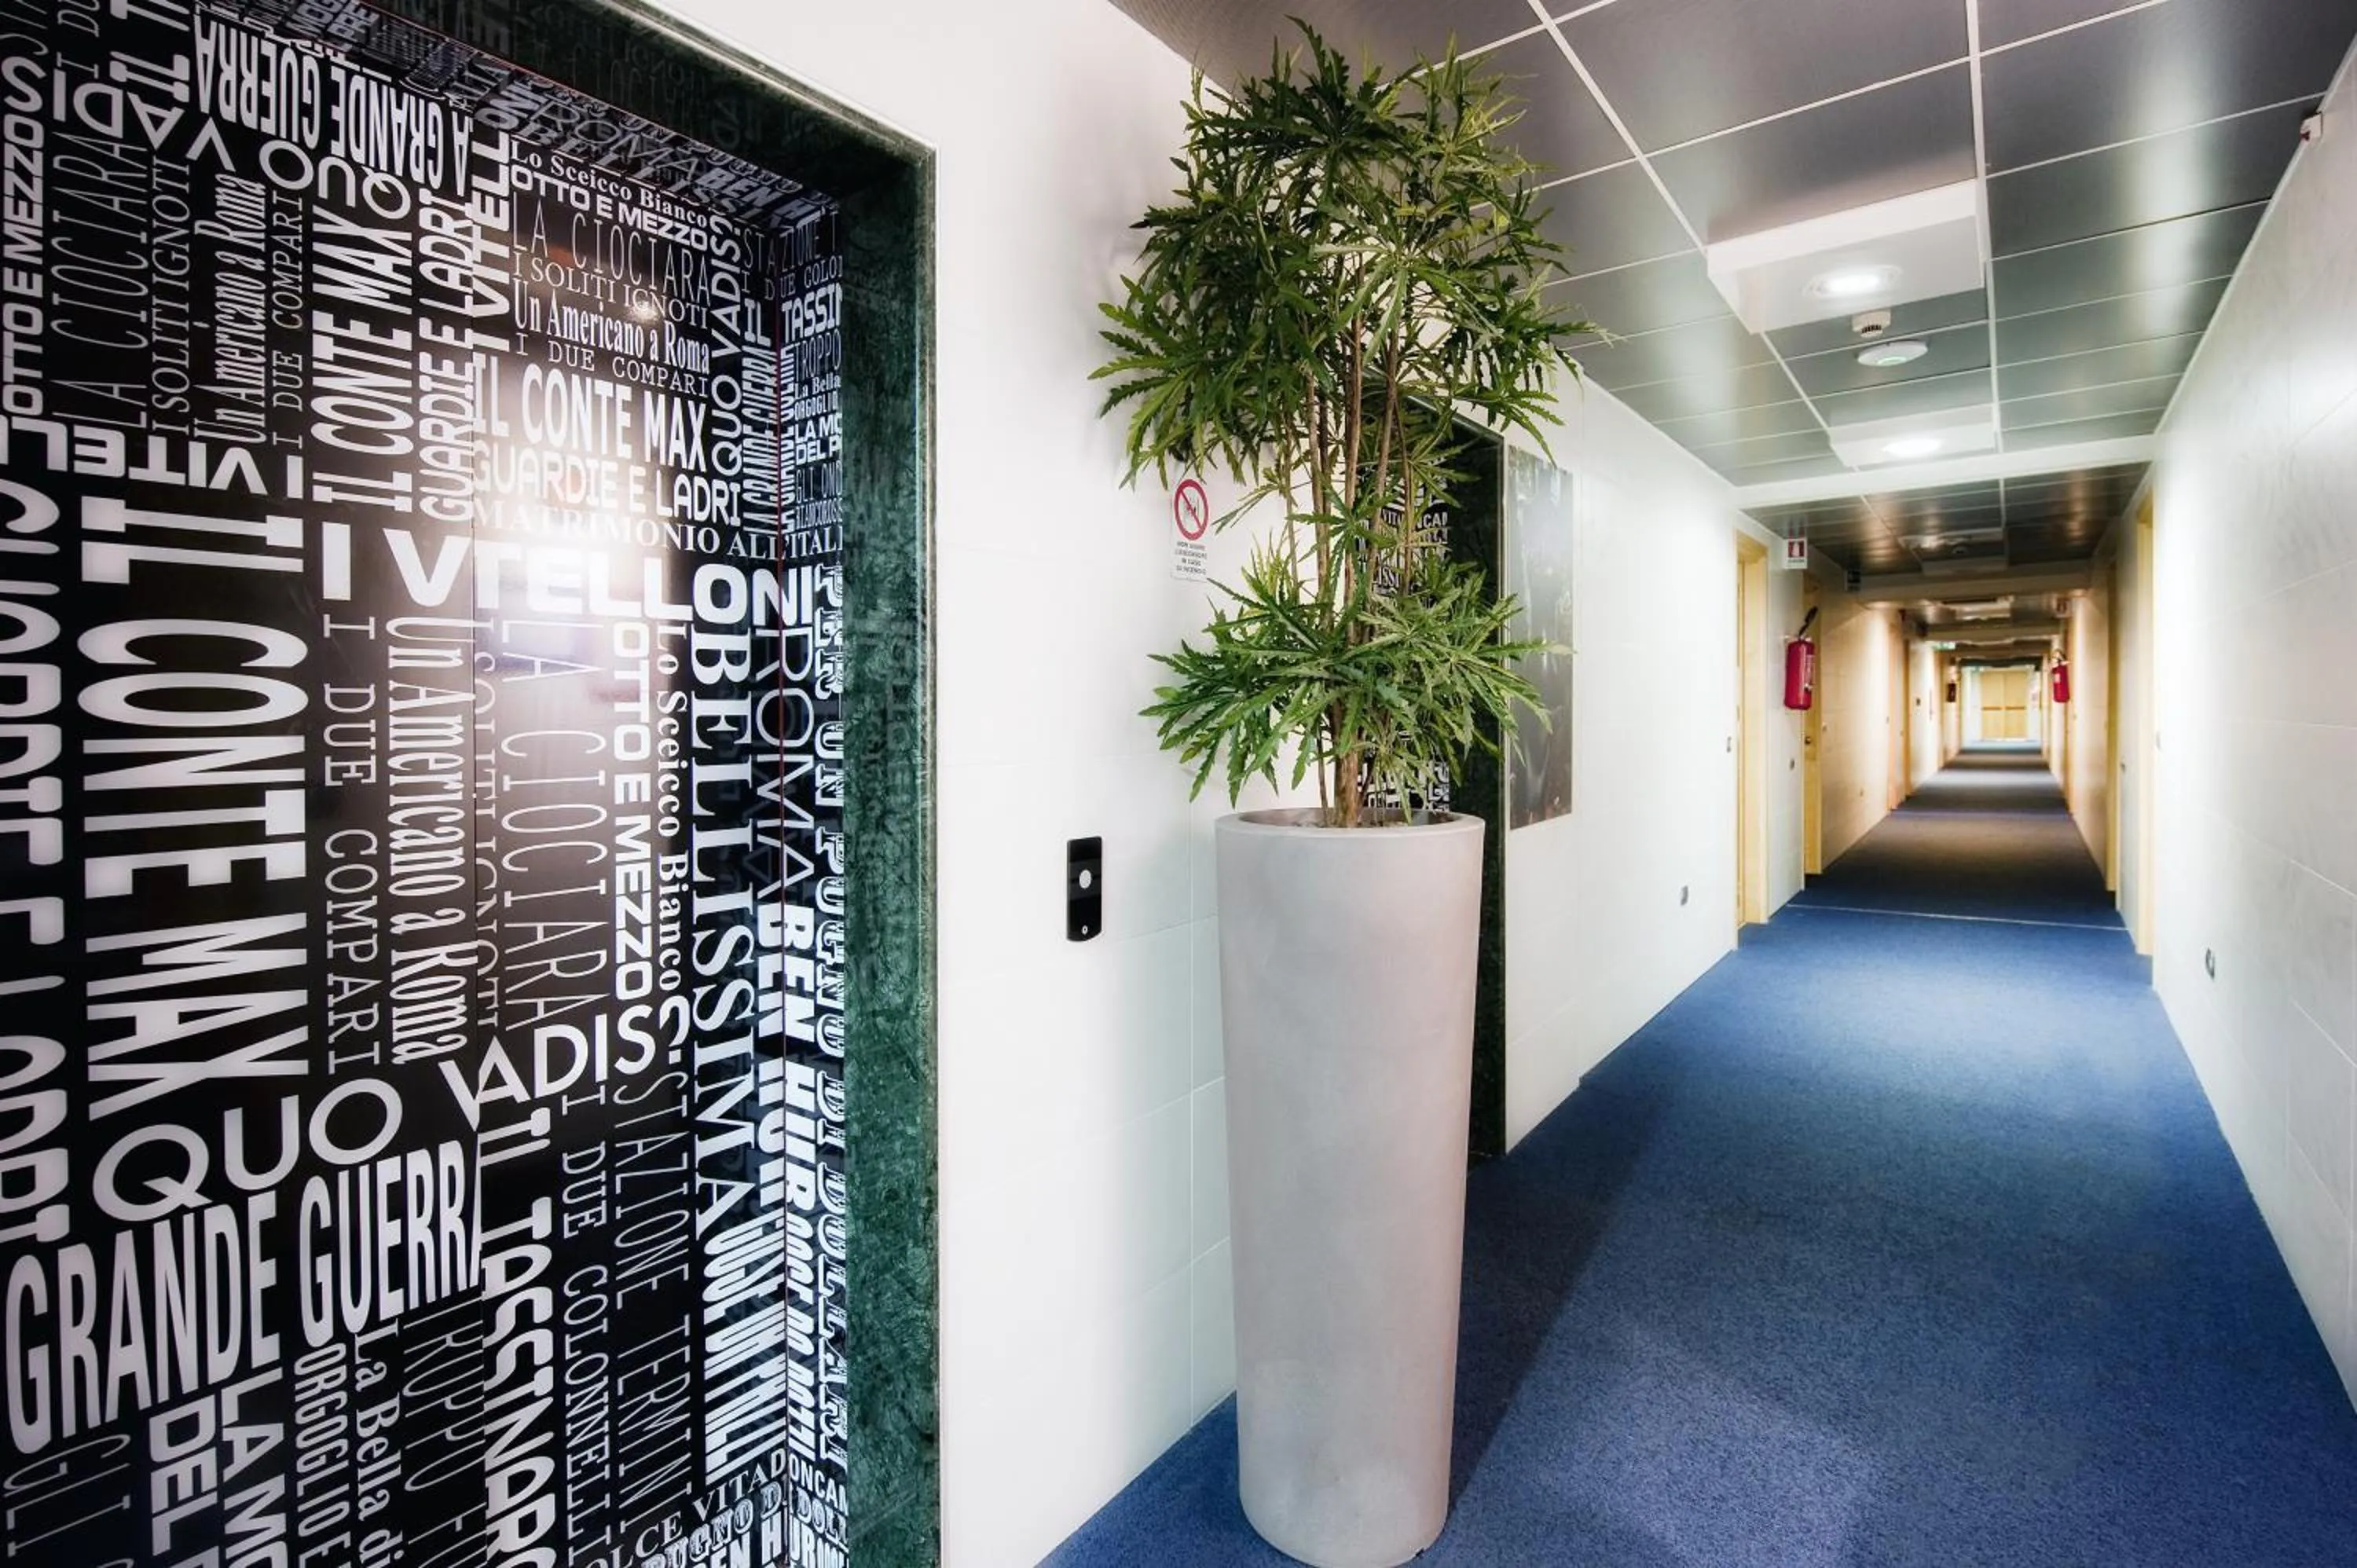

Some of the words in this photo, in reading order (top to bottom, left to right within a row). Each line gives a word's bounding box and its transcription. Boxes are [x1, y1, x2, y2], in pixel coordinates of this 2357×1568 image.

[194, 14, 321, 150] GUERRA
[330, 66, 443, 190] GRANDE
[2, 114, 44, 265] MEZZO
[152, 155, 189, 291] IGNOTI
[194, 173, 266, 252] Roma
[259, 139, 411, 220] QUO
[511, 141, 542, 171] Lo
[551, 154, 632, 200] Sceicco
[639, 185, 707, 229] Bianco
[511, 163, 590, 216] OTTO
[597, 200, 614, 218] E
[618, 203, 709, 251] MEZZO
[2, 268, 43, 299] E
[51, 131, 148, 350] CIOCIARA
[214, 251, 266, 271] a
[272, 190, 303, 330] COMPARI
[312, 203, 413, 313] MAX
[419, 191, 473, 317] LADRI
[513, 192, 548, 258] LA
[572, 212, 710, 308] CIOCIARA
[513, 251, 523, 278] I
[531, 256, 617, 303] SOLITI
[624, 281, 709, 330] IGNOTI
[709, 214, 742, 368] VADIS?
[2, 302, 43, 416] OTTO
[152, 295, 189, 412] SOLITI
[193, 274, 266, 408] Americano
[273, 350, 303, 412] DUE
[310, 309, 414, 456] CONTE
[419, 316, 473, 350] E
[471, 326, 510, 352] I
[513, 278, 541, 333] Un
[547, 297, 644, 361] Americano
[649, 332, 660, 362] a
[664, 323, 709, 375] Roma
[515, 334, 530, 357] I
[549, 343, 596, 372] DUE
[612, 357, 709, 398] COMPARI
[52, 378, 148, 429] LA
[152, 419, 189, 434] I
[194, 408, 266, 443] Un
[273, 432, 302, 449] I
[419, 351, 473, 522] GUARDIE
[472, 352, 509, 438] IL
[522, 365, 632, 462] CONTE
[644, 392, 708, 472] MAX
[711, 375, 742, 477] QUO
[82, 496, 304, 584] IL
[313, 471, 413, 513] IL
[473, 441, 619, 509] GUARDIE
[629, 465, 647, 513] E
[656, 470, 742, 526] LADRI
[322, 522, 351, 600] I
[383, 527, 814, 627] VTELLONI
[323, 614, 376, 639] I
[386, 616, 475, 668] Un
[502, 618, 607, 683] LA
[614, 621, 651, 762] OTTO
[655, 625, 687, 676] Lo
[78, 618, 308, 899] CONTE
[323, 683, 377, 786] DUE
[387, 680, 476, 897] Americano
[614, 772, 651, 805] E
[655, 690, 688, 838] Sceicco
[754, 624, 816, 901] ROMA
[389, 908, 467, 936] a
[500, 730, 610, 1031] CIOCIARA
[614, 815, 653, 1001] MEZZO
[657, 853, 689, 991] Bianco
[691, 624, 756, 1240] BELLISSIMA
[324, 829, 382, 1075] COMPARI
[390, 940, 478, 1065] Roma
[757, 903, 816, 1043] BEN
[86, 912, 309, 1121] MAX
[93, 1078, 403, 1222] QUO
[438, 995, 691, 1132] VADIS?
[562, 1086, 607, 1116] I
[758, 1056, 817, 1210] HUR
[563, 1140, 607, 1239] DUE
[613, 1070, 689, 1310] STAZIONE
[5, 1190, 281, 1454] GRANDE
[354, 1318, 399, 1393] La
[221, 1366, 284, 1484] LA
[294, 1342, 350, 1538] ORGOGLIO
[356, 1391, 402, 1522] Bella
[563, 1263, 612, 1568] COLONNELLI
[617, 1313, 692, 1534] TERMINI
[2, 1434, 132, 1559] GLI
[148, 1394, 218, 1557] DEL
[692, 1463, 771, 1522] VITA
